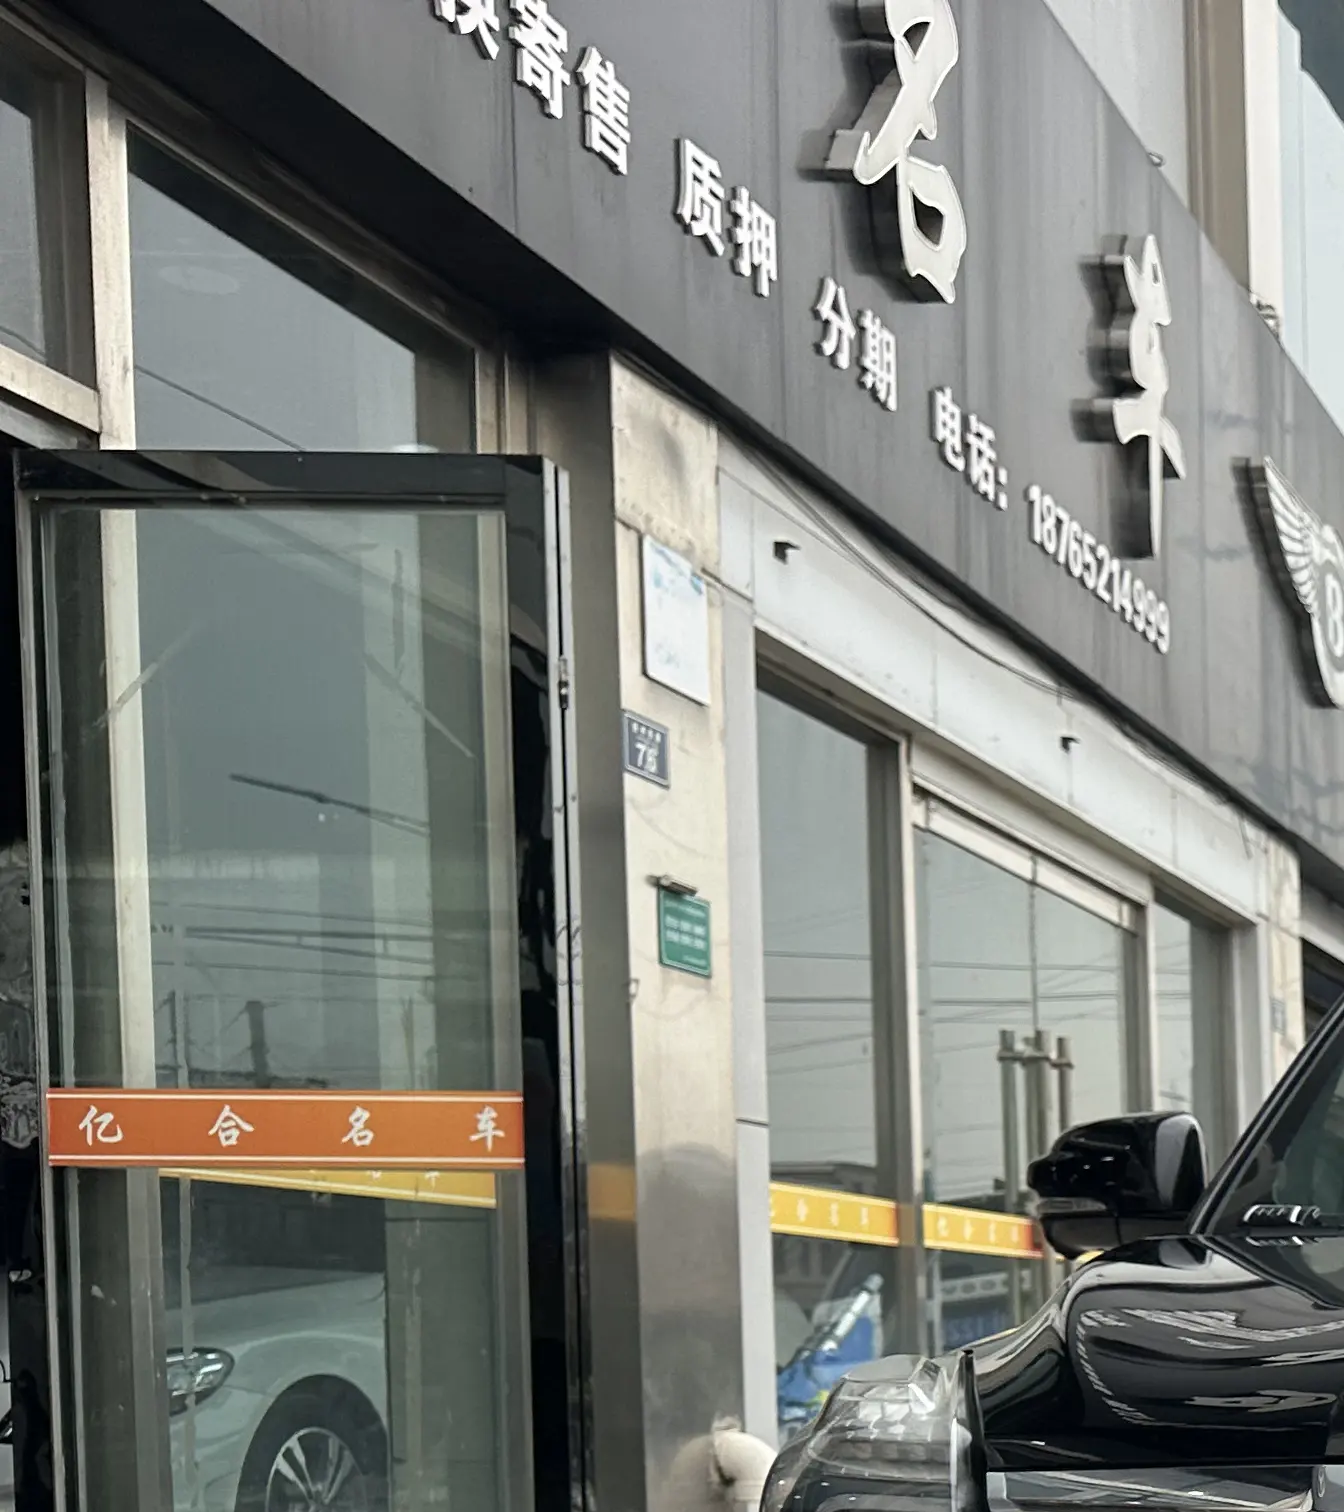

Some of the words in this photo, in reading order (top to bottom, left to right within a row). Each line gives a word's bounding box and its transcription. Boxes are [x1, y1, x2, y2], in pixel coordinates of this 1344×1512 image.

[677, 137, 778, 298] 质押
[814, 276, 898, 412] 分期
[1028, 484, 1171, 655] 18765214999
[78, 1104, 506, 1151] 亿合名车
